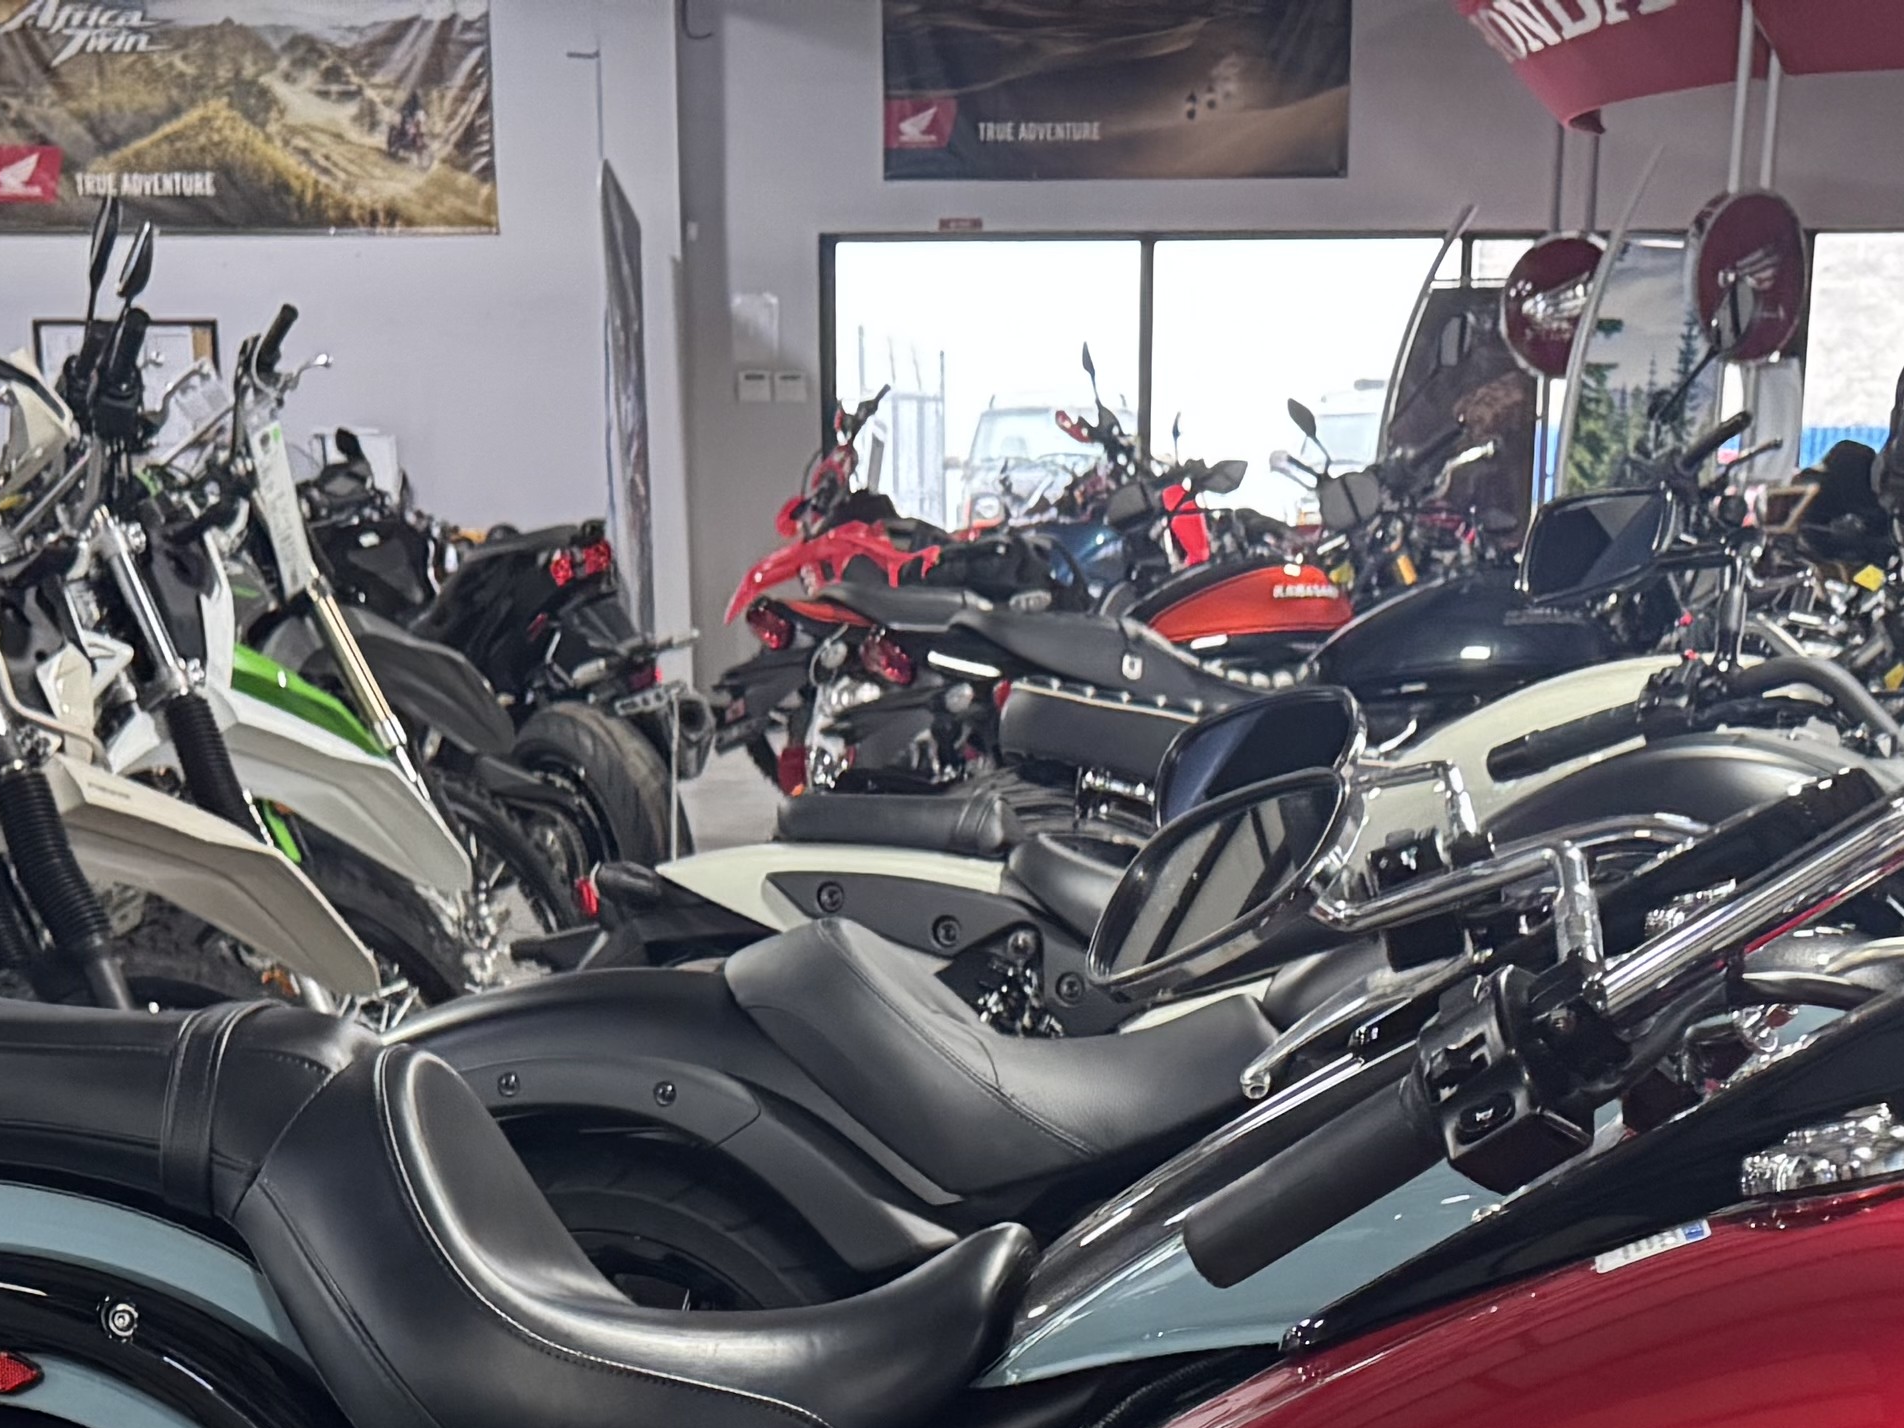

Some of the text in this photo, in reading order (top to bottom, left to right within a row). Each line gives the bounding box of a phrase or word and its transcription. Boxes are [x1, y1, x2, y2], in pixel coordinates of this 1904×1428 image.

[978, 121, 1102, 142] TRUE ADVENTURE
[75, 171, 216, 197] TRUE ADVENTURE
